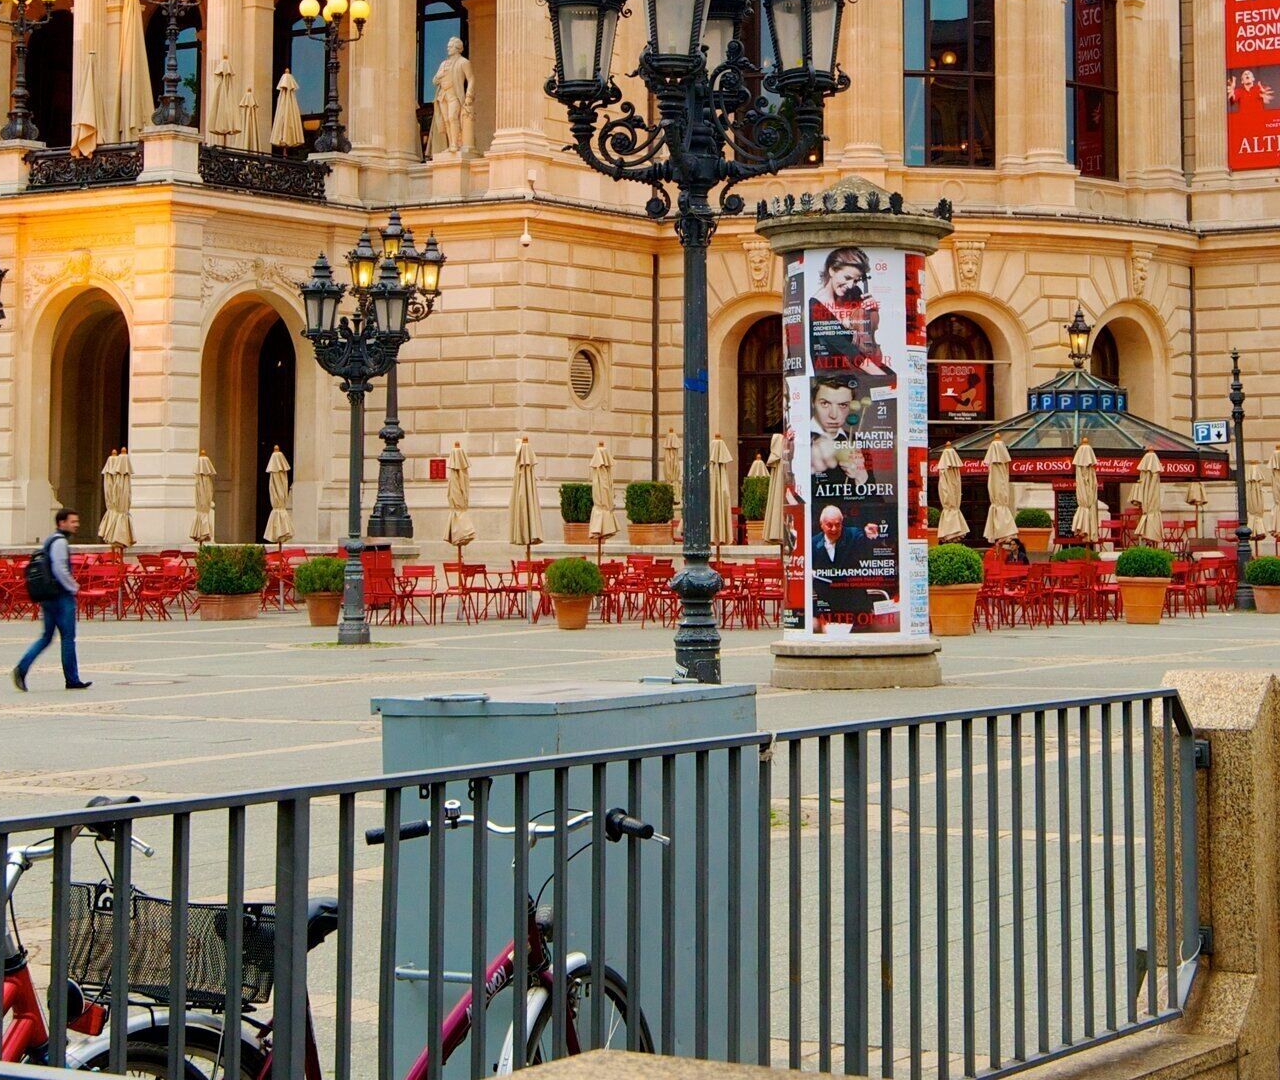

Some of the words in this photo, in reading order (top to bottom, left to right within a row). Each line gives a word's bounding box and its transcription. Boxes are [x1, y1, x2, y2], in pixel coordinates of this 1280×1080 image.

[875, 262, 888, 271] 08
[877, 406, 887, 415] 21
[855, 431, 893, 440] MARTIN
[833, 440, 894, 449] GRUBINGER
[1012, 461, 1034, 471] Café
[1036, 461, 1072, 471] ROSSO
[1113, 460, 1134, 468] Käfer
[1166, 463, 1195, 473] ROSSO
[815, 484, 853, 497] ALTE
[855, 483, 894, 496] OPER
[879, 524, 889, 533] 17
[860, 560, 895, 568] WIENER
[816, 568, 895, 577] PHILHARMONIKER
